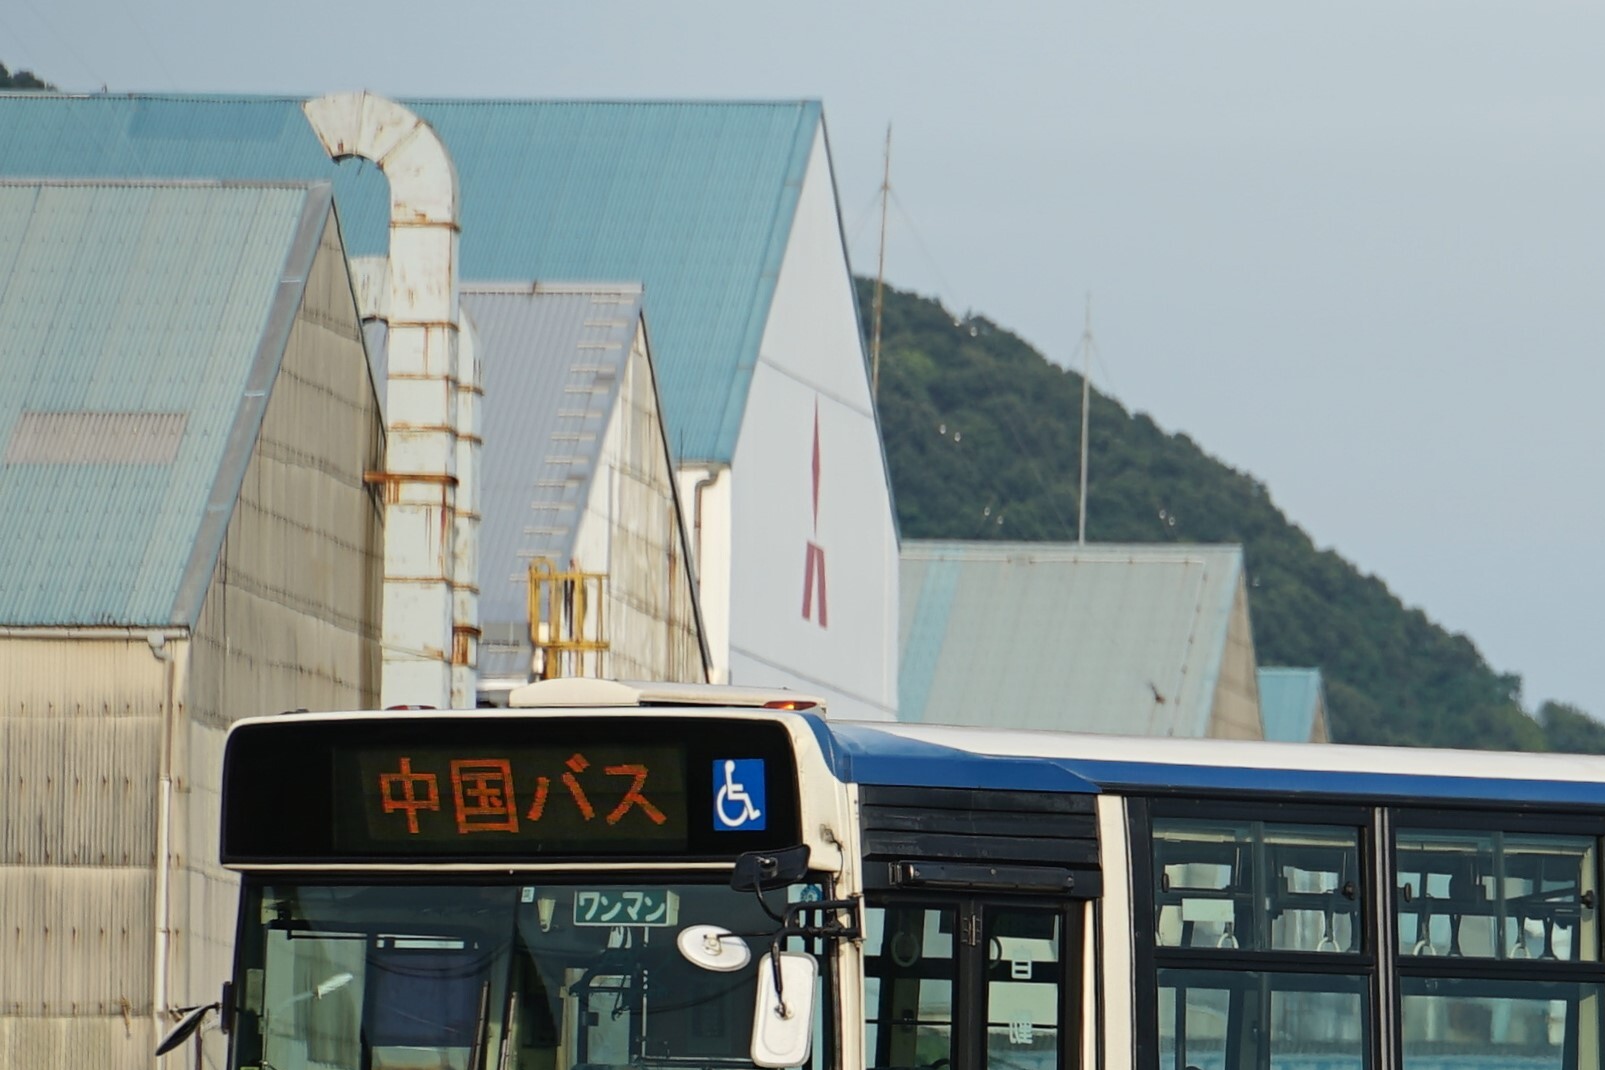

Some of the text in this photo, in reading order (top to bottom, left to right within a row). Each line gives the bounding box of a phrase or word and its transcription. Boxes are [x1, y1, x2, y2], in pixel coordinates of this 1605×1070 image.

[379, 753, 668, 834] 中国バス
[578, 891, 666, 922] ワンマン
